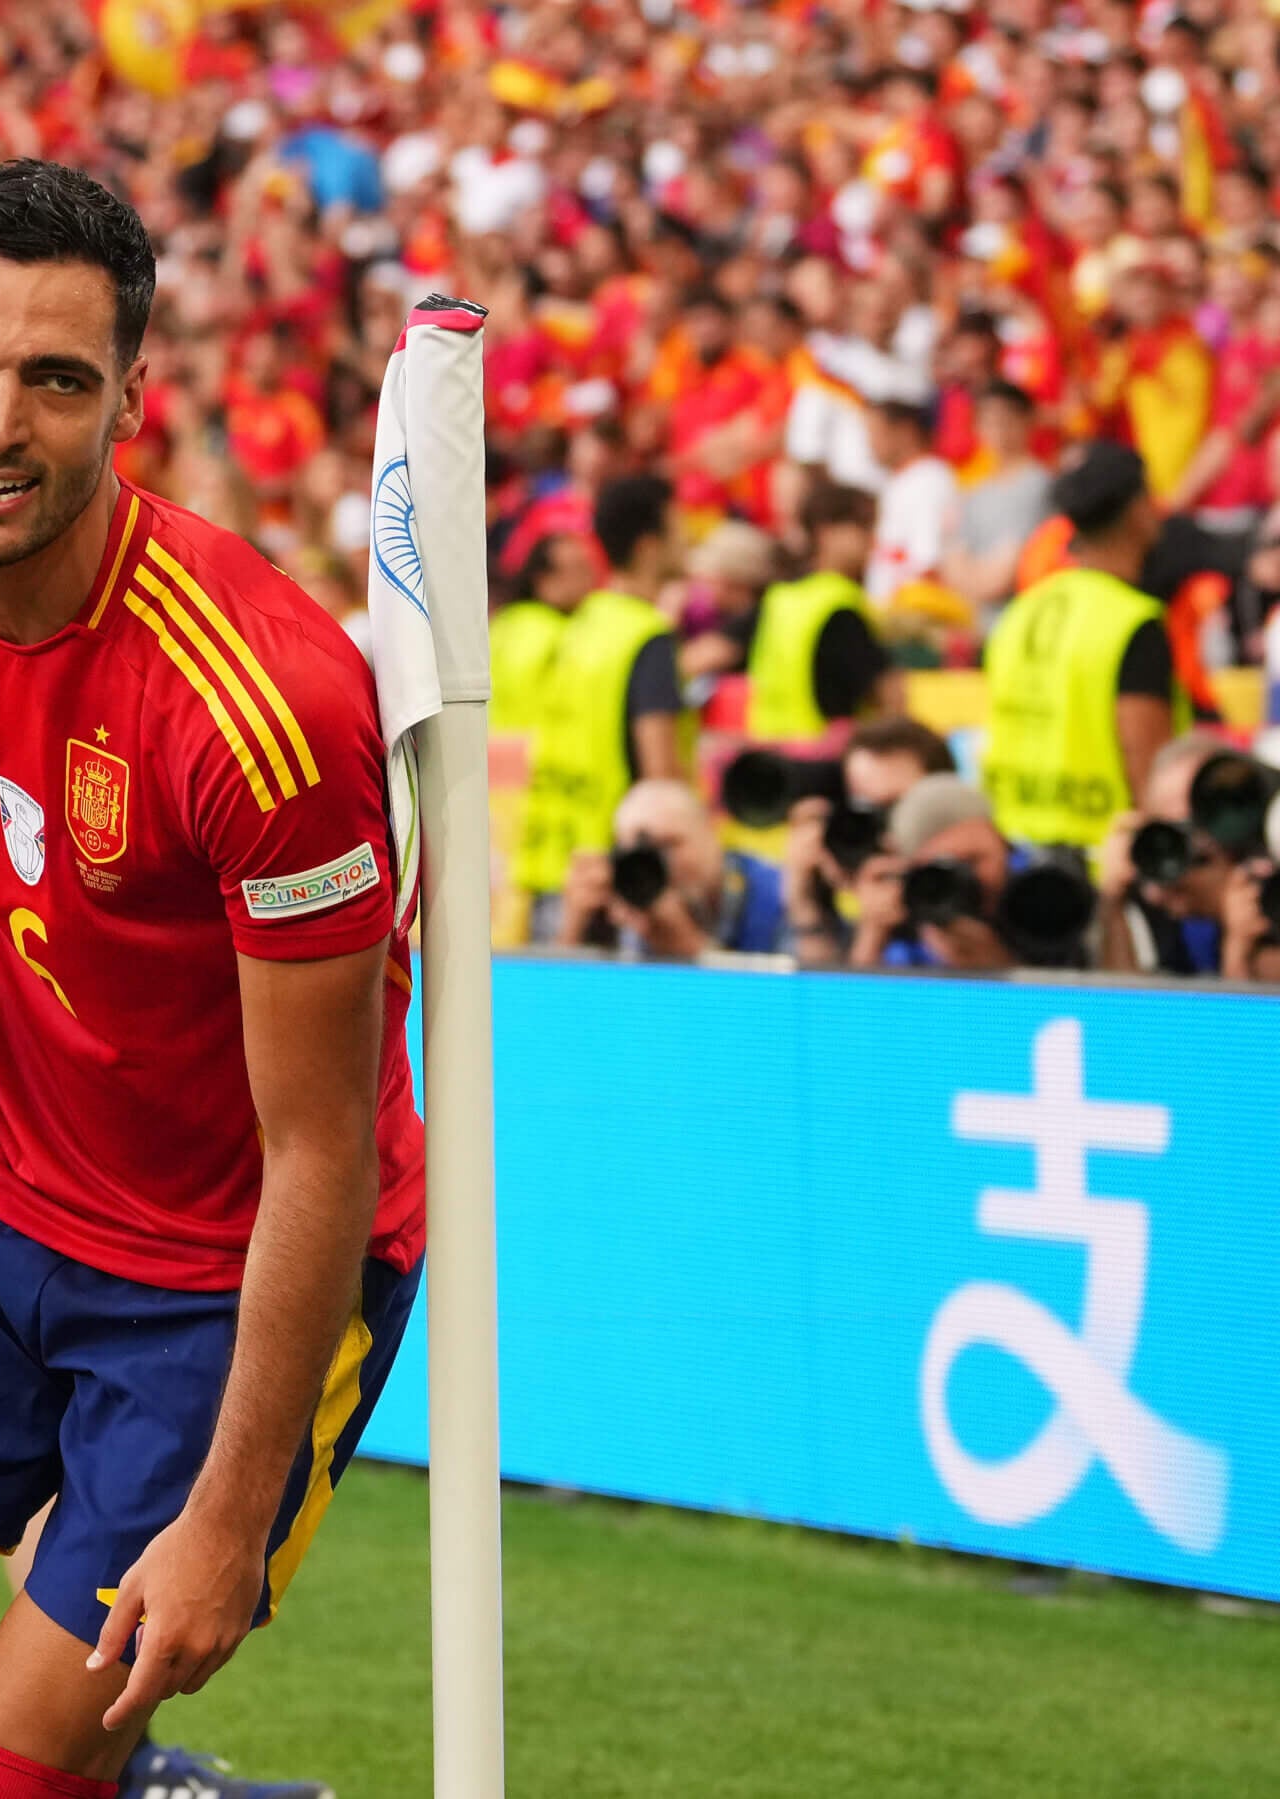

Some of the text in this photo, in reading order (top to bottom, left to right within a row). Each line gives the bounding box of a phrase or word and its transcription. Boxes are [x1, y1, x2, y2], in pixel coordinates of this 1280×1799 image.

[248, 856, 374, 905] FOUNDATION
[246, 881, 277, 892] UEFA
[342, 888, 352, 899] for
